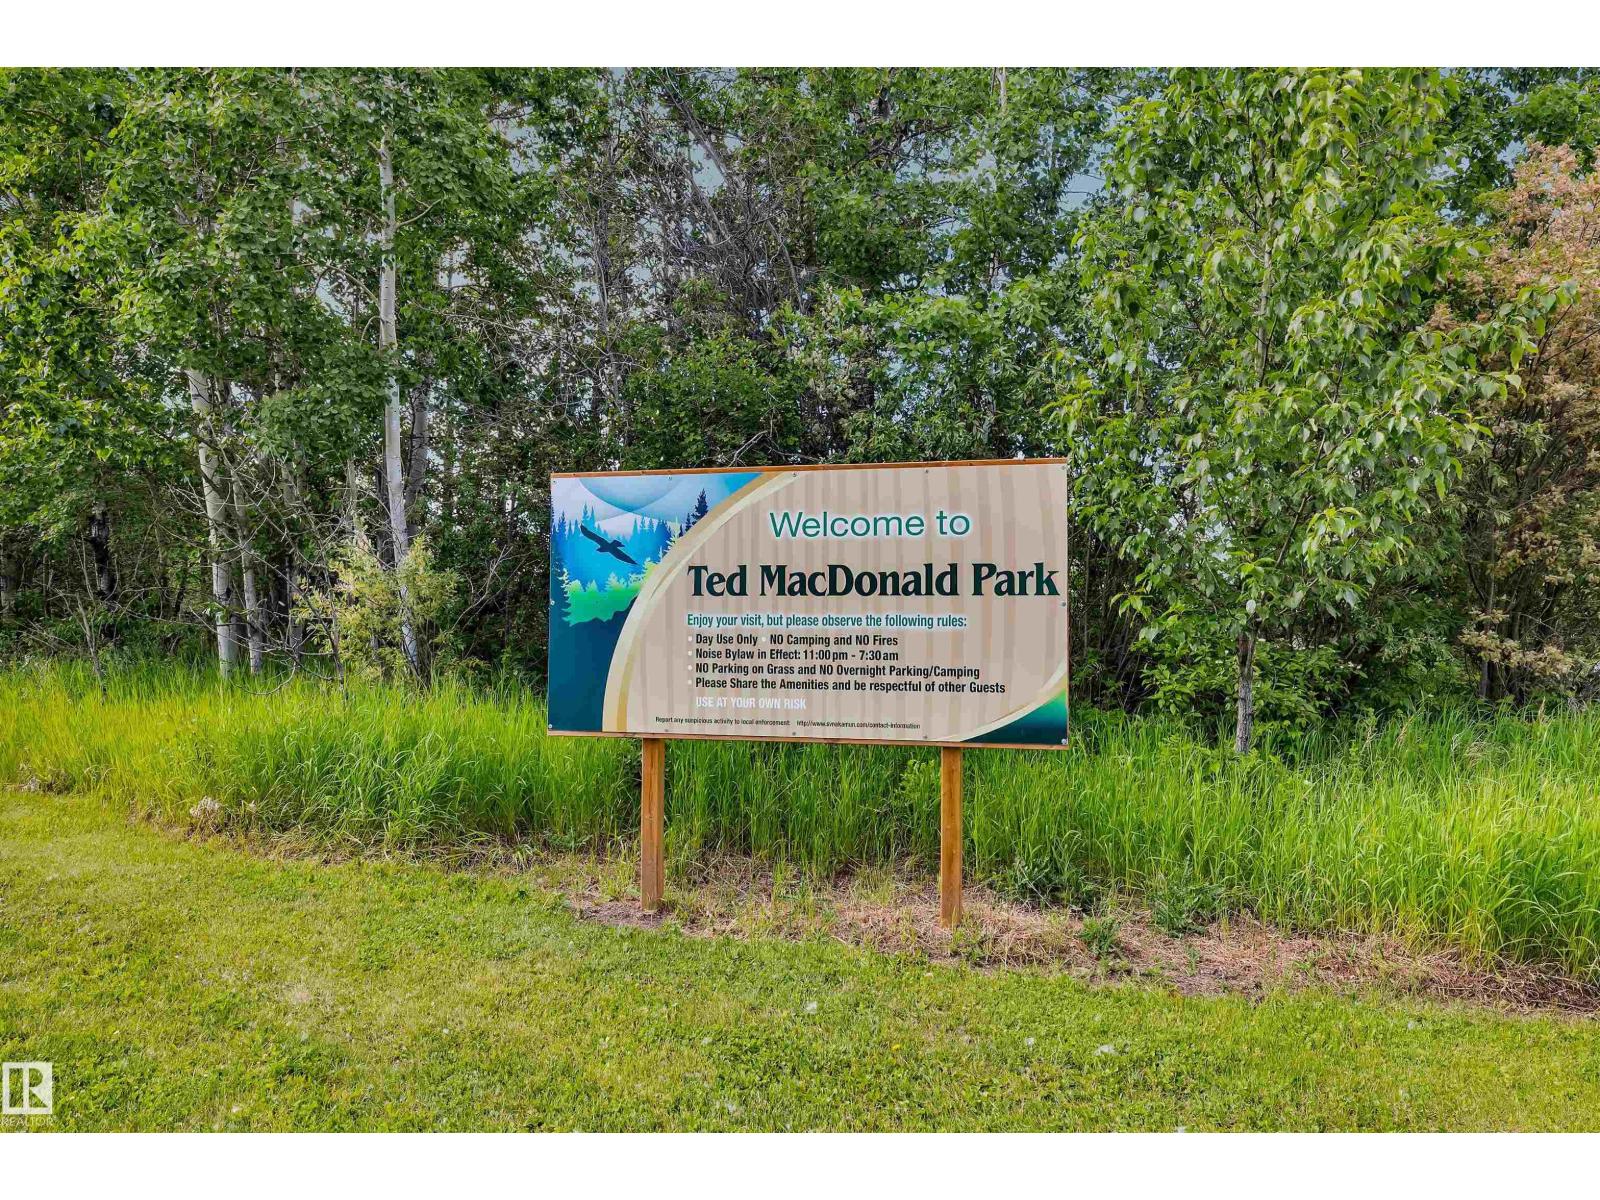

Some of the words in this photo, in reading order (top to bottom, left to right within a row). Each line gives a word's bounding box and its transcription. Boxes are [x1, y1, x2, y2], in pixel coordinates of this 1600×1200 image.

[769, 511, 925, 538] Welcome
[935, 510, 970, 536] to
[687, 564, 749, 596] Ted
[759, 562, 960, 596] MacDonald
[971, 562, 1060, 596] Park
[687, 614, 713, 628] Enjoy
[716, 616, 738, 628] your
[740, 614, 764, 628] visit,
[767, 614, 783, 626] but
[786, 614, 819, 628] please
[822, 614, 862, 627] observe
[865, 615, 882, 627] the
[885, 614, 934, 629] following
[937, 615, 967, 627] rules:
[695, 634, 713, 646] Day
[716, 634, 734, 645] Use
[737, 634, 758, 646] Only
[770, 634, 784, 645] NO
[787, 634, 831, 647] Camping
[834, 635, 852, 645] and
[855, 635, 869, 646] NO
[873, 635, 898, 646] Fires
[695, 648, 722, 659] Noise
[725, 649, 755, 661] Bylaw
[757, 649, 766, 659] in
[770, 649, 801, 660] Effect:
[695, 663, 709, 673] NO
[712, 663, 749, 676] Parking
[752, 666, 764, 674] on
[767, 664, 795, 675] Grass
[798, 665, 816, 675] and
[820, 665, 833, 675] NO
[837, 665, 886, 678] Overnight
[889, 665, 980, 679] Parking/Camping
[695, 678, 727, 689] Please
[730, 678, 758, 689] Share
[761, 679, 776, 689] the
[779, 679, 829, 690] Amenities
[832, 679, 851, 690] and
[854, 680, 866, 691] be
[869, 681, 921, 693] respectful
[925, 681, 935, 692] of
[938, 682, 966, 692] other
[969, 682, 1006, 693] Guests
[695, 697, 714, 708] USE
[715, 697, 727, 708] AT
[731, 697, 756, 709] YOUR
[758, 698, 781, 709] OWN
[783, 698, 806, 709] RISK
